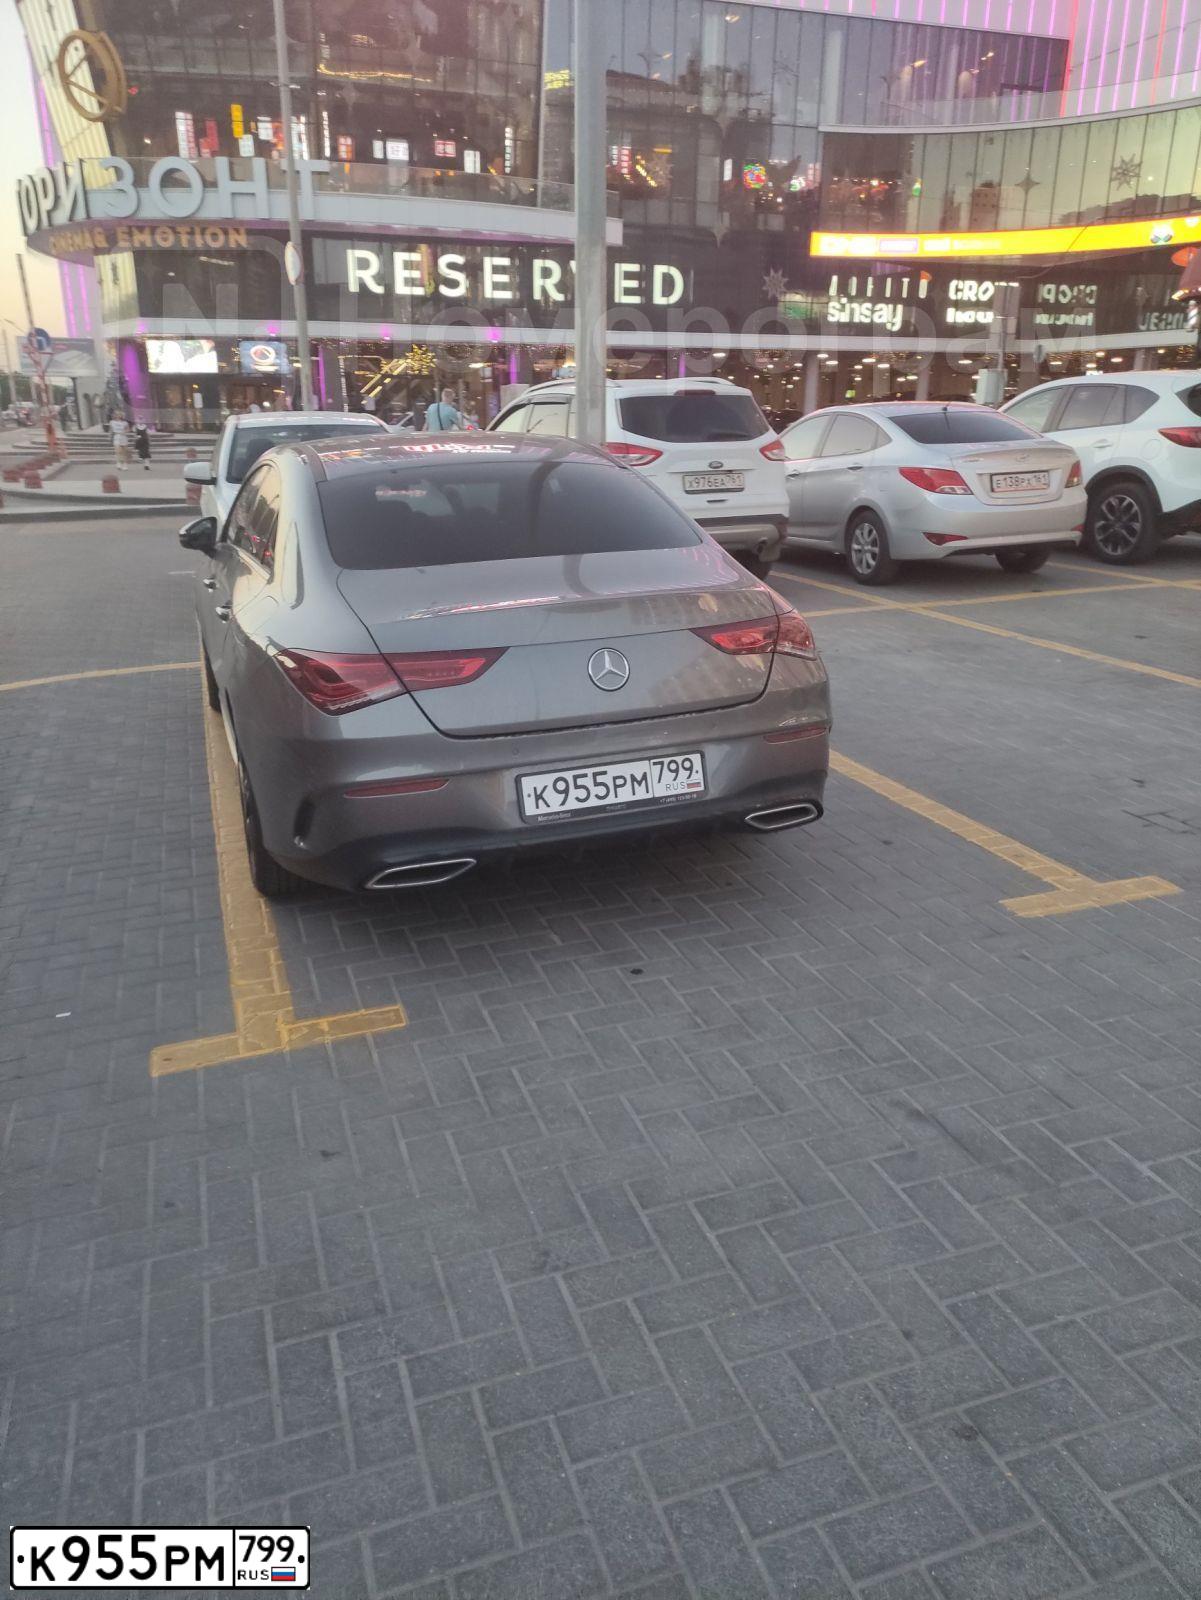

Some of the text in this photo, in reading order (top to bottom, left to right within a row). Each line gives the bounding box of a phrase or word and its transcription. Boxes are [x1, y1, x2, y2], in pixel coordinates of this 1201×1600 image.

[116, 226, 247, 249] EMOTION
[346, 249, 684, 305] RESERED
[948, 279, 1019, 301] CRO
[827, 297, 903, 332] sinsay
[533, 757, 694, 809] К955РМ 799
[665, 781, 686, 792] RUS
